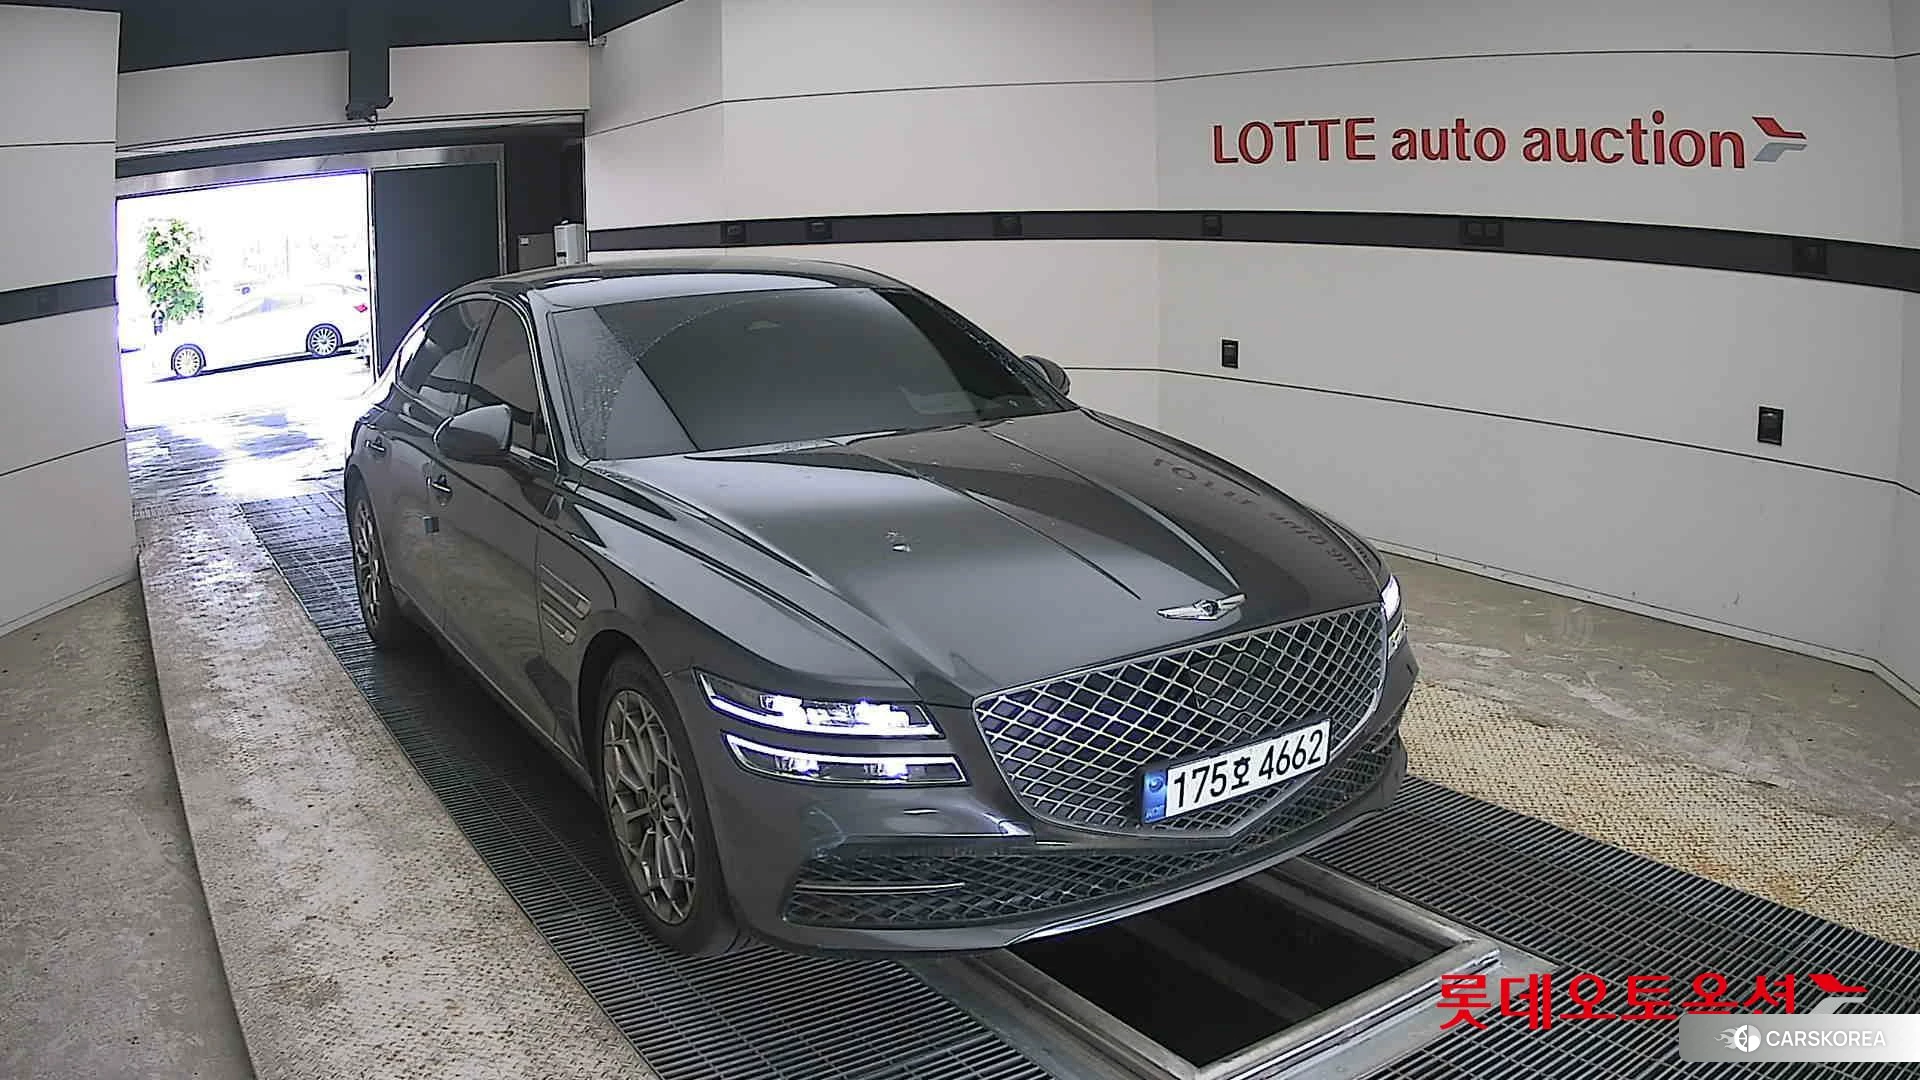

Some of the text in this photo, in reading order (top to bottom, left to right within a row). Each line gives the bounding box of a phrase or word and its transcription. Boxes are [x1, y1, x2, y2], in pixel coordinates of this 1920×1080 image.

[1213, 110, 1746, 169] LOTTE auto auction
[1174, 729, 1323, 808] 175호 4662
